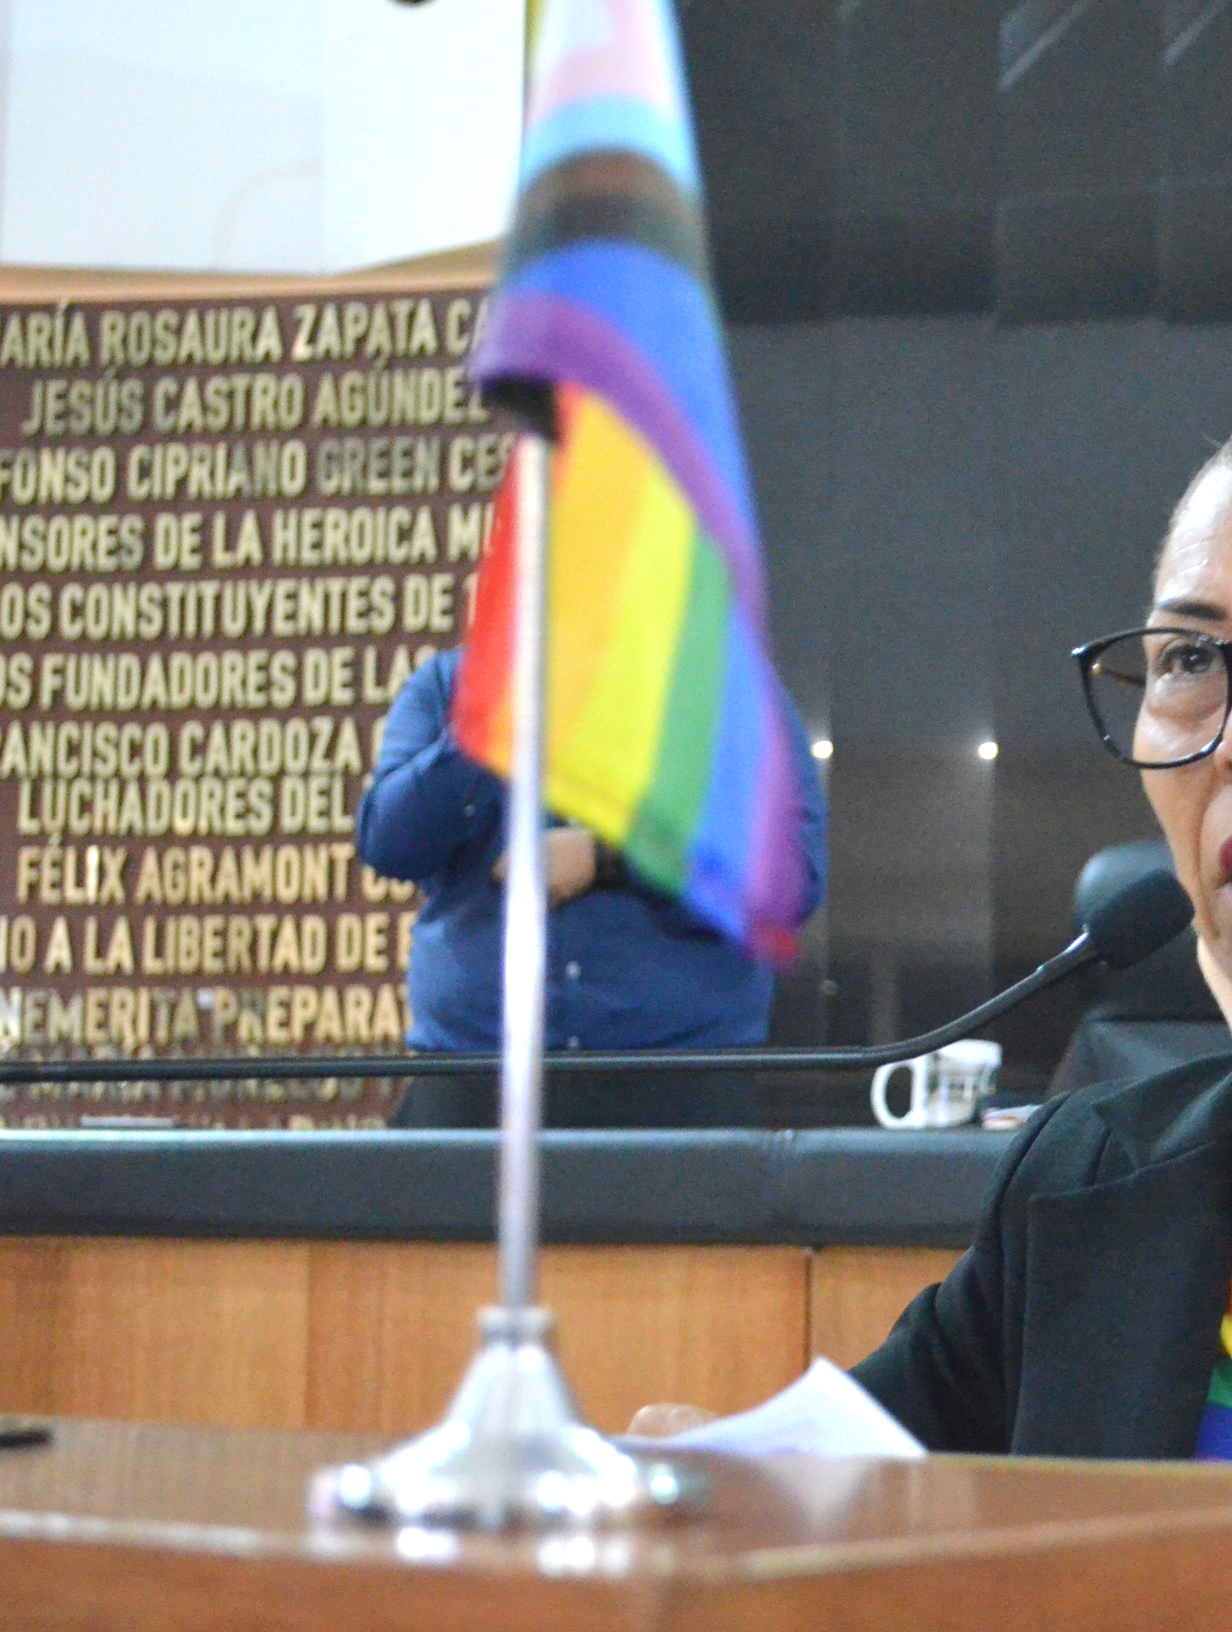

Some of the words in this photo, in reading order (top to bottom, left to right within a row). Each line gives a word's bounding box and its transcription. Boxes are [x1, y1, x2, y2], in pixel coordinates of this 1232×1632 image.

[100, 306, 283, 367] ROSAURA
[291, 301, 438, 363] ZAPATA
[20, 367, 144, 436] JESÚS
[152, 374, 305, 434] CASTRO
[126, 440, 307, 502] CIPRIANO
[317, 437, 440, 496] GREEN
[0, 514, 144, 572] NSORES
[154, 511, 203, 570] DE
[212, 509, 263, 568] LA
[273, 505, 438, 568] HEROICA
[58, 575, 396, 640] CONSTITUYENTES
[403, 573, 455, 634] DE
[0, 652, 34, 710] S
[40, 649, 298, 709] FUNDADORES
[304, 646, 354, 705] DE
[362, 643, 437, 704] LA
[0, 720, 170, 778] ANCISCO
[179, 716, 361, 777] CARDOZA
[16, 777, 274, 836] LUCHADORES
[280, 775, 356, 835] DEL
[16, 832, 128, 904] FÉLIX
[136, 843, 357, 903] AGRAMONT
[0, 914, 37, 976] O
[44, 914, 72, 975] A
[83, 914, 134, 975] LA
[142, 913, 328, 976] LIBERTAD
[336, 911, 391, 974] DE
